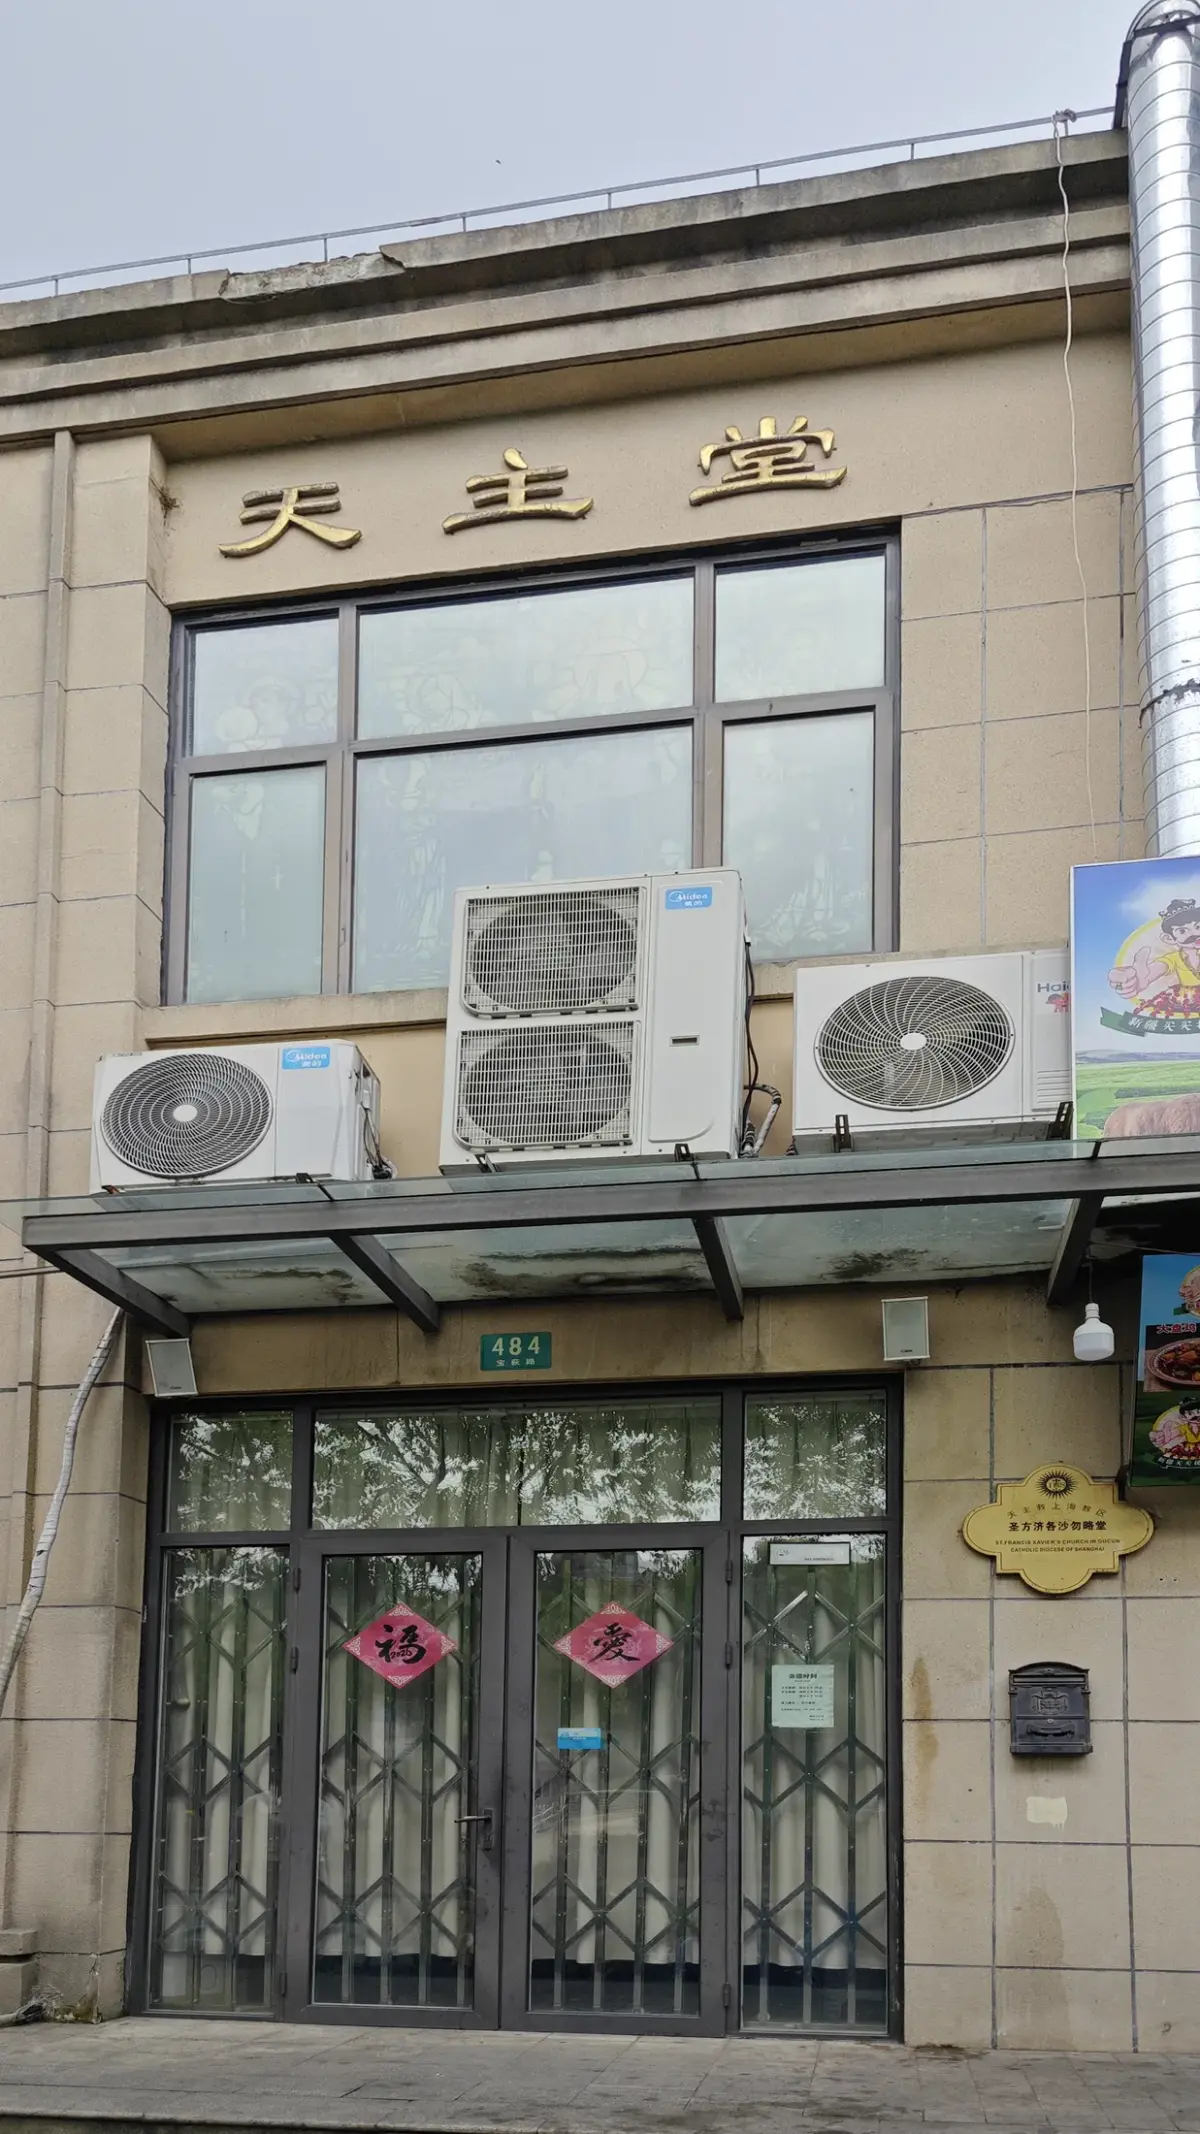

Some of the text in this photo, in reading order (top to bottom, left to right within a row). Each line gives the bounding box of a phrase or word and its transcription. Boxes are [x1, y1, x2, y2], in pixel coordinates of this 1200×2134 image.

[218, 415, 848, 559] 天主堂
[674, 892, 708, 902] Midea
[1128, 1016, 1200, 1032] 新疆买买
[290, 1051, 328, 1062] Midea
[491, 1335, 541, 1356] 484
[1007, 1502, 1107, 1519] 天主教上海教区
[1008, 1520, 1107, 1532] 圣方济各沙勿略堂
